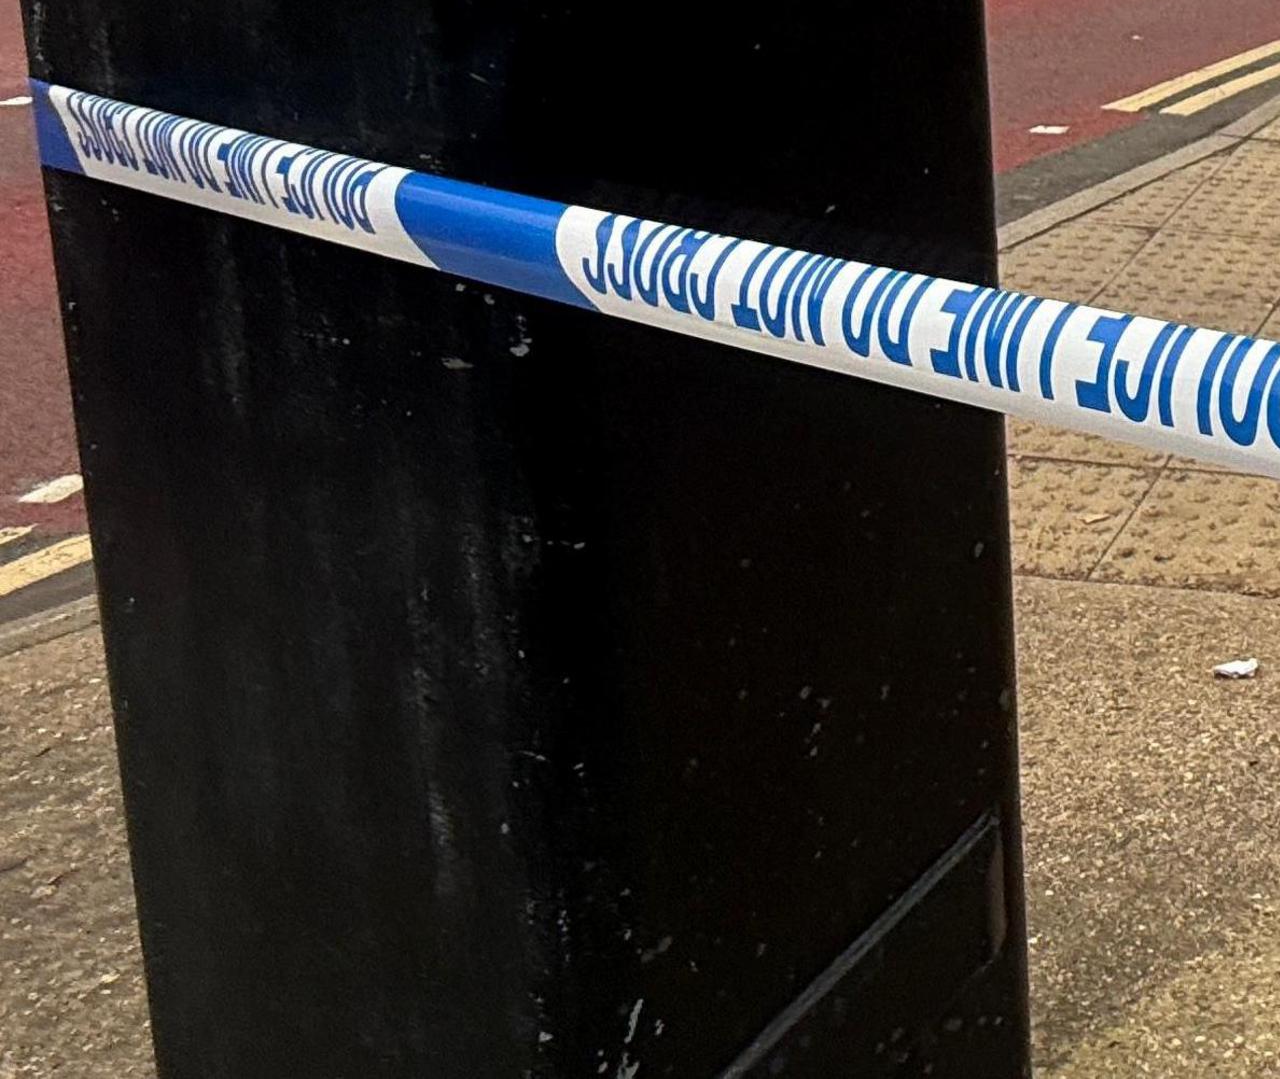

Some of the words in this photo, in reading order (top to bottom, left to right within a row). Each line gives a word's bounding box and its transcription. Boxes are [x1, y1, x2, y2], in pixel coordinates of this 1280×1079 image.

[581, 212, 741, 322] CROSS
[731, 245, 847, 347] NOT
[841, 264, 936, 368] DO
